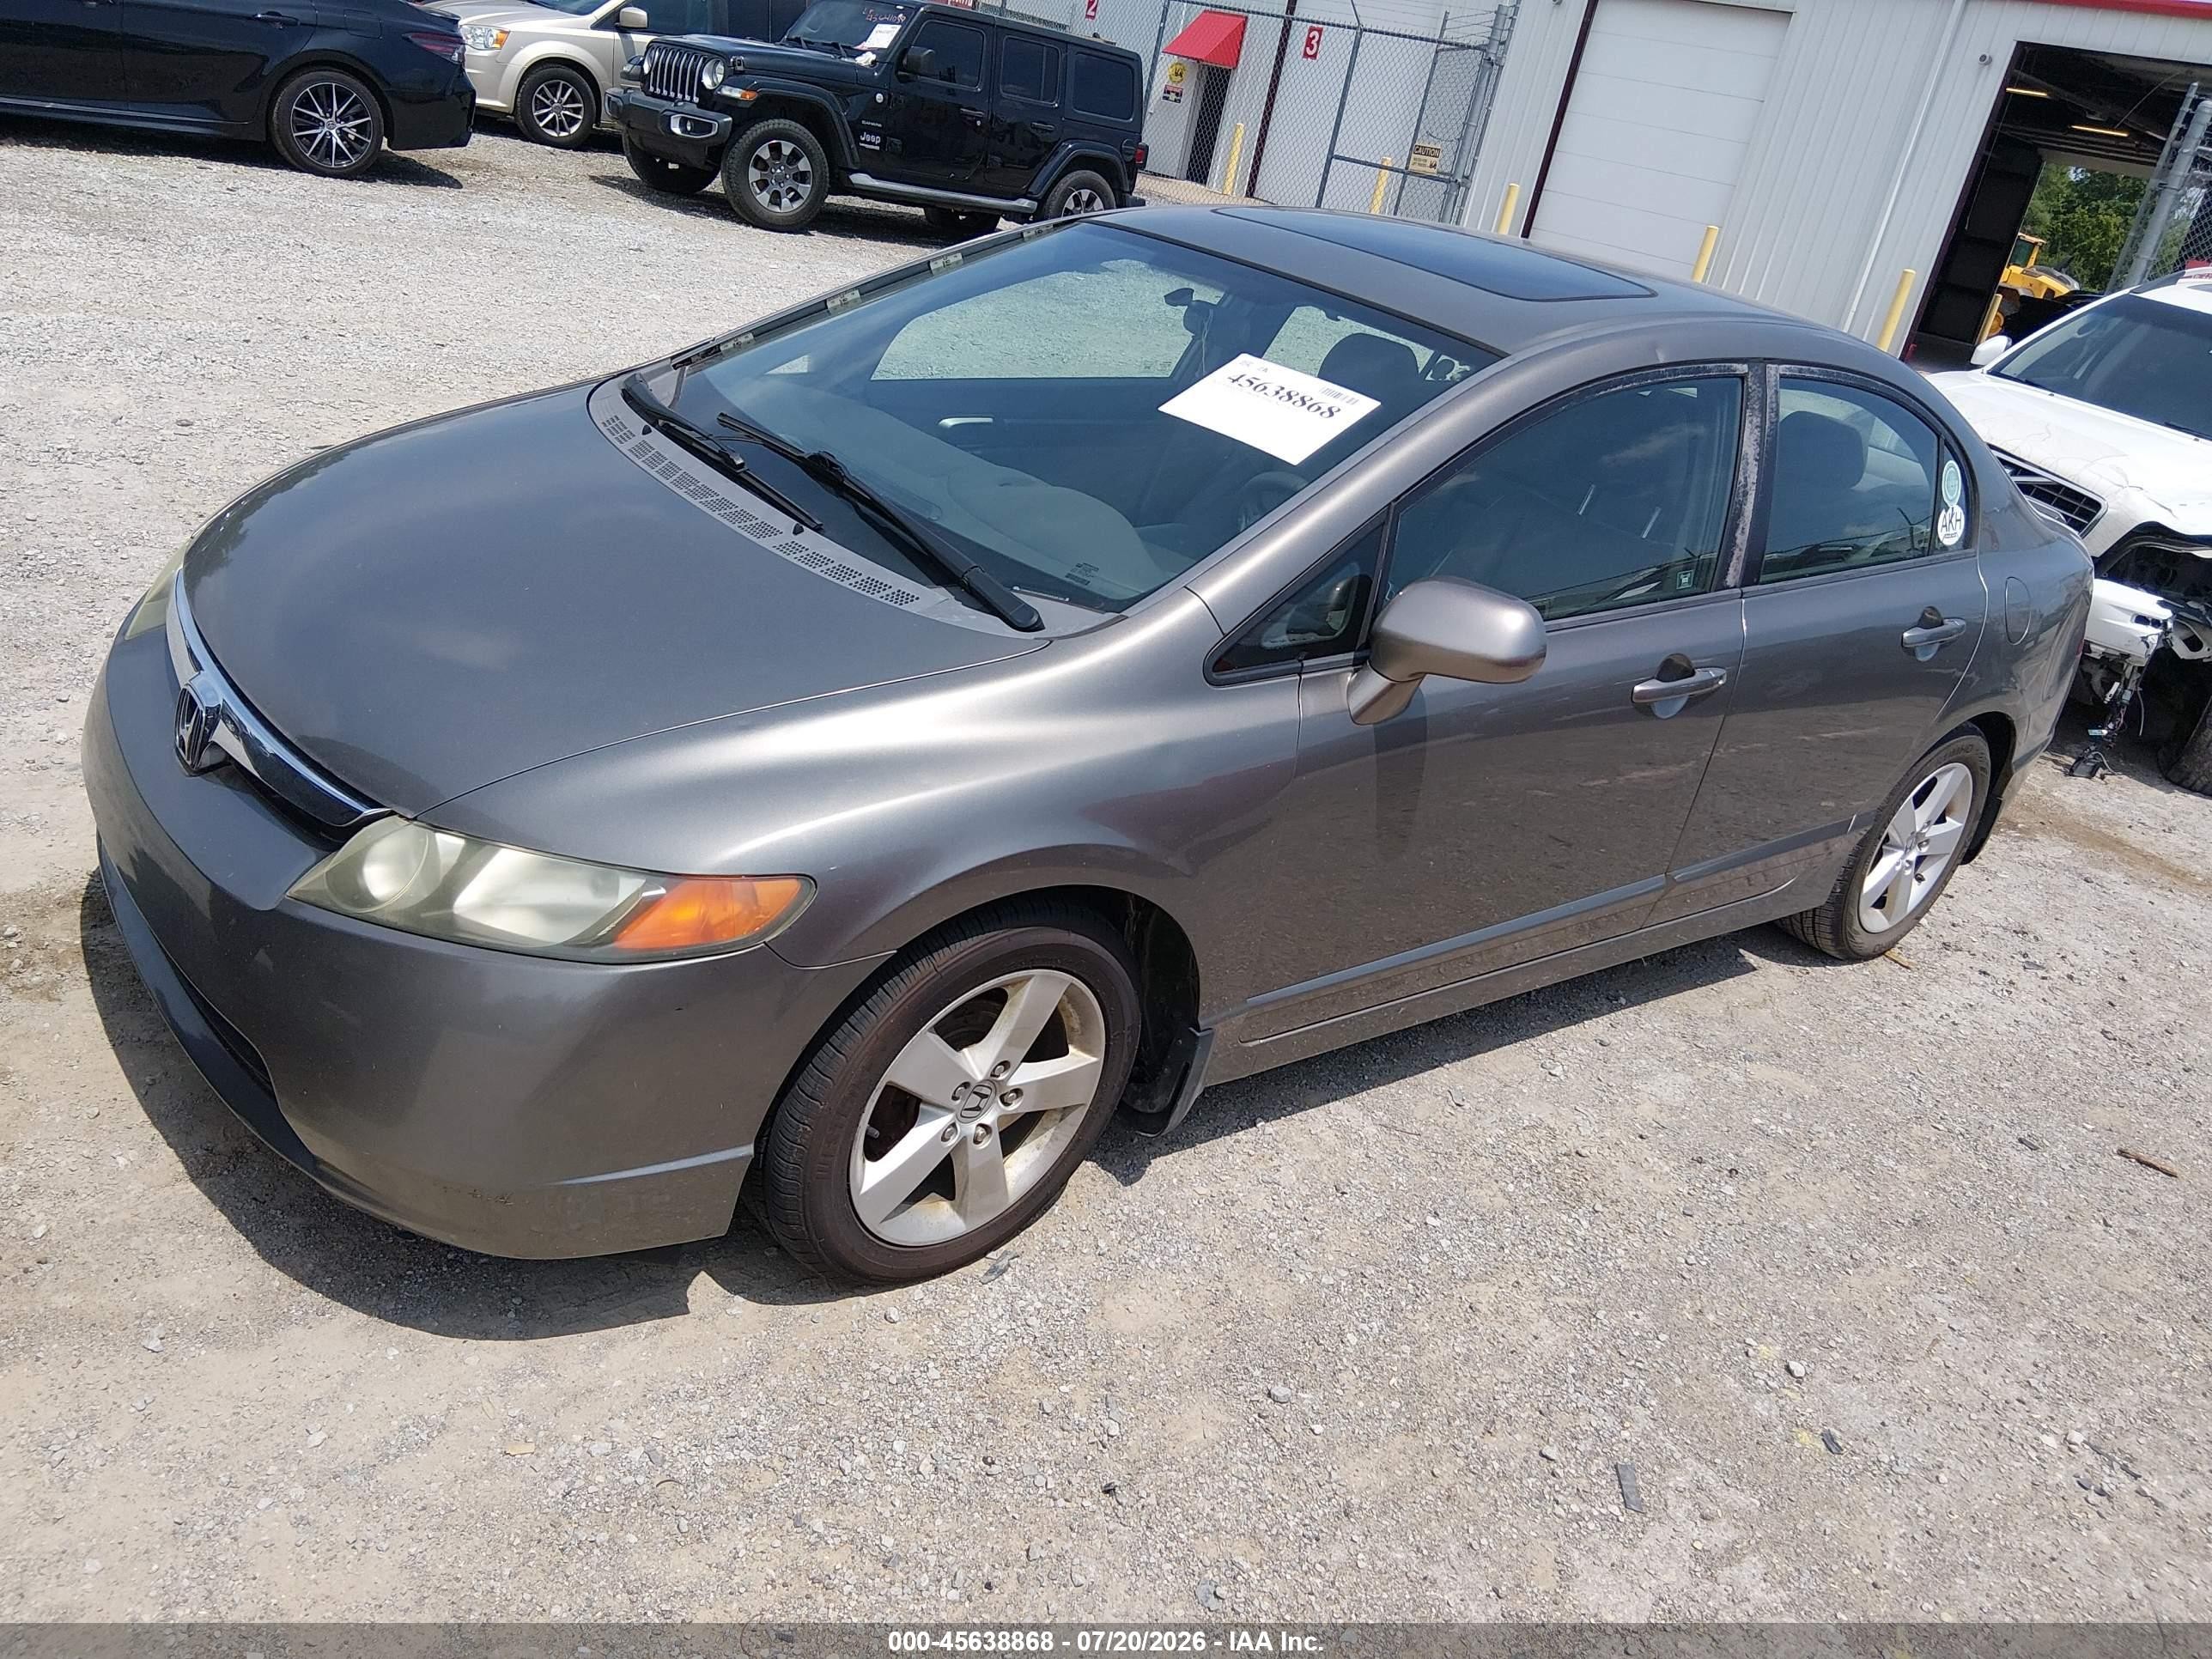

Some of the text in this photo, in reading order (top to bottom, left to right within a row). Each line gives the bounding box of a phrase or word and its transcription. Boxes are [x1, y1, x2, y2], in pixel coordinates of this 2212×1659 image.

[1086, 0, 1097, 15] 2
[1306, 31, 1320, 55] 3
[860, 131, 881, 144] Jeep
[1413, 146, 1441, 157] CAUTION
[1227, 374, 1341, 418] 45638868
[1941, 508, 1962, 533] AKH
